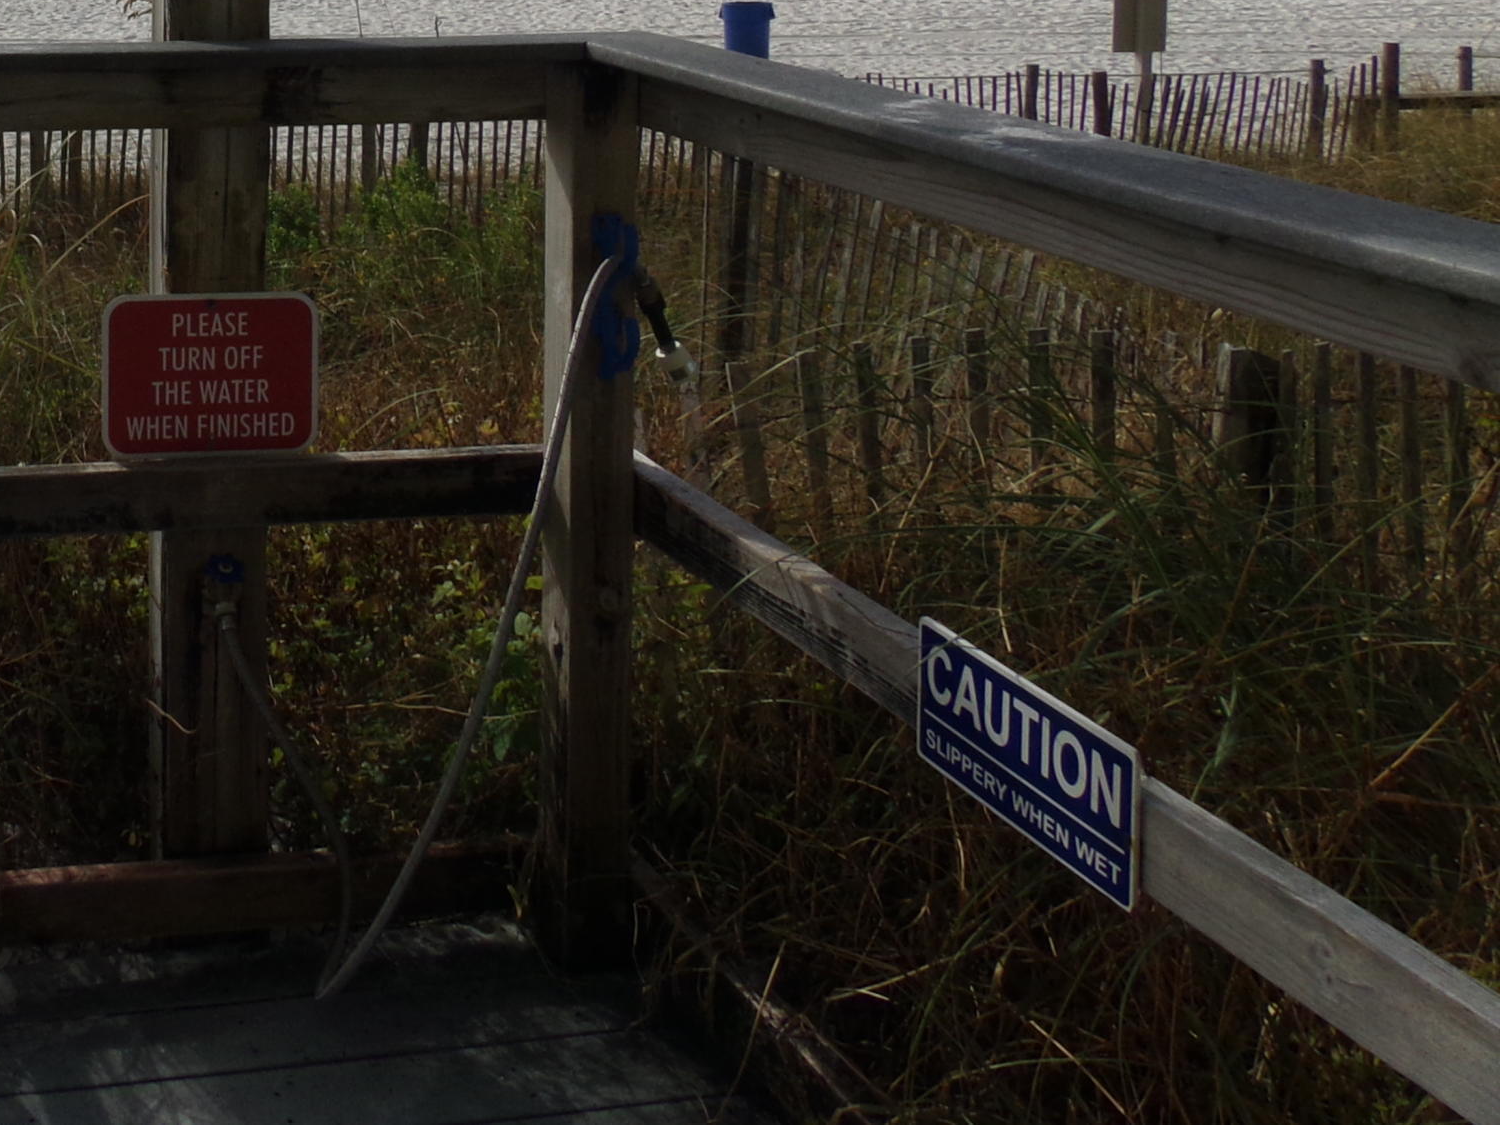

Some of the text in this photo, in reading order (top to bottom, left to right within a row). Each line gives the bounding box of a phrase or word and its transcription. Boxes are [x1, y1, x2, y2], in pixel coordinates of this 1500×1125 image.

[172, 312, 249, 337] PLEASE
[158, 345, 264, 372] TURN OFF
[152, 379, 269, 406] THE WATER
[126, 412, 295, 441] WHEN FINISHED
[927, 645, 1122, 829] CAUTION
[925, 728, 1122, 885] SLIPPERY WHEN WET
